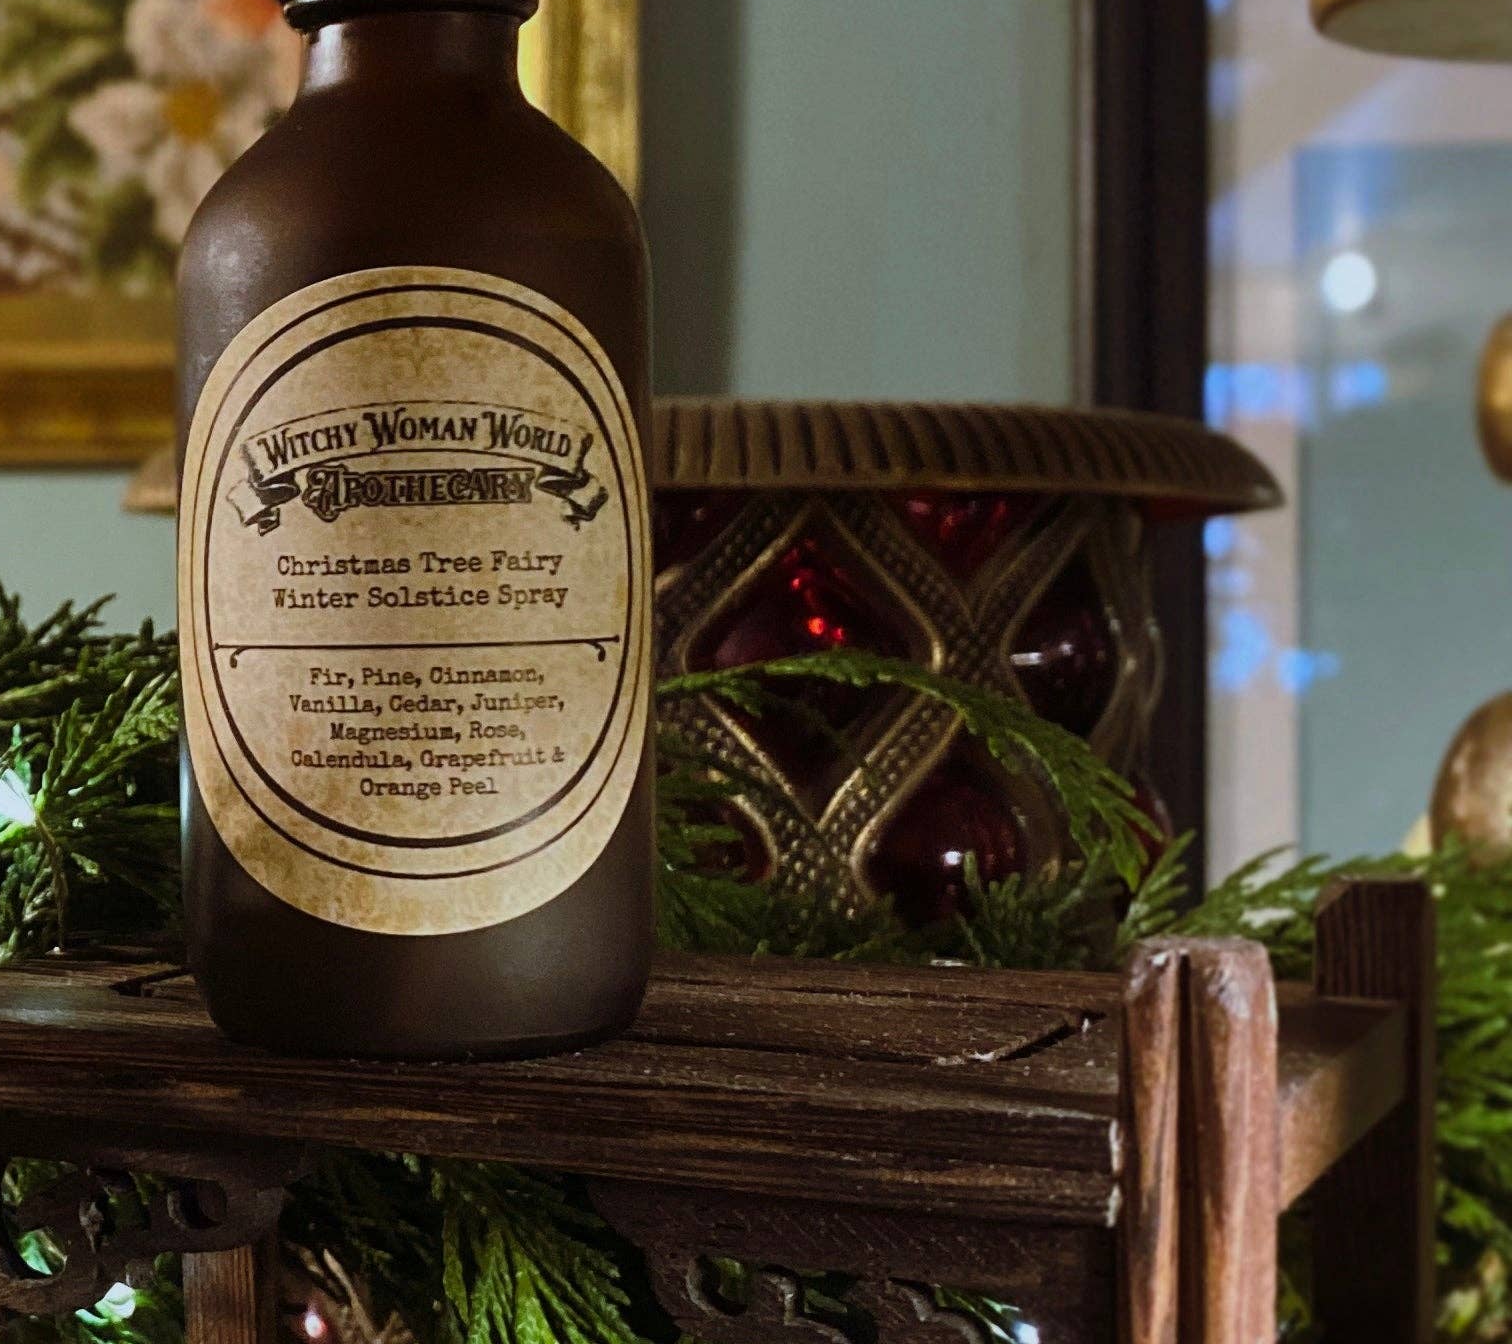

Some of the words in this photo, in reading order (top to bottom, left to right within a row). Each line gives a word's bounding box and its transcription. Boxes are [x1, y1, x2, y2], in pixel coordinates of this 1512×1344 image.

[362, 408, 478, 449] WOMAN
[481, 411, 571, 457] WORLD
[277, 555, 410, 576] Christmas
[419, 552, 482, 574] Tree
[491, 550, 563, 576] Fairy
[272, 588, 358, 609] Winter
[367, 586, 489, 607] Solstice
[497, 584, 569, 609] Spray
[309, 667, 355, 689] Fir,
[362, 667, 422, 688] Pine,
[429, 666, 545, 685] Cinnamon,
[289, 695, 383, 715] Vanilla,
[389, 694, 464, 715] Cedar,
[470, 693, 565, 712] Juniper,
[330, 722, 462, 744] Magnesium,
[468, 720, 526, 741] Rose,
[291, 750, 412, 772] Calendula,
[419, 749, 545, 772] Grapefruit
[551, 747, 565, 763] &
[360, 778, 441, 800] Orange
[449, 777, 498, 796] Peel
